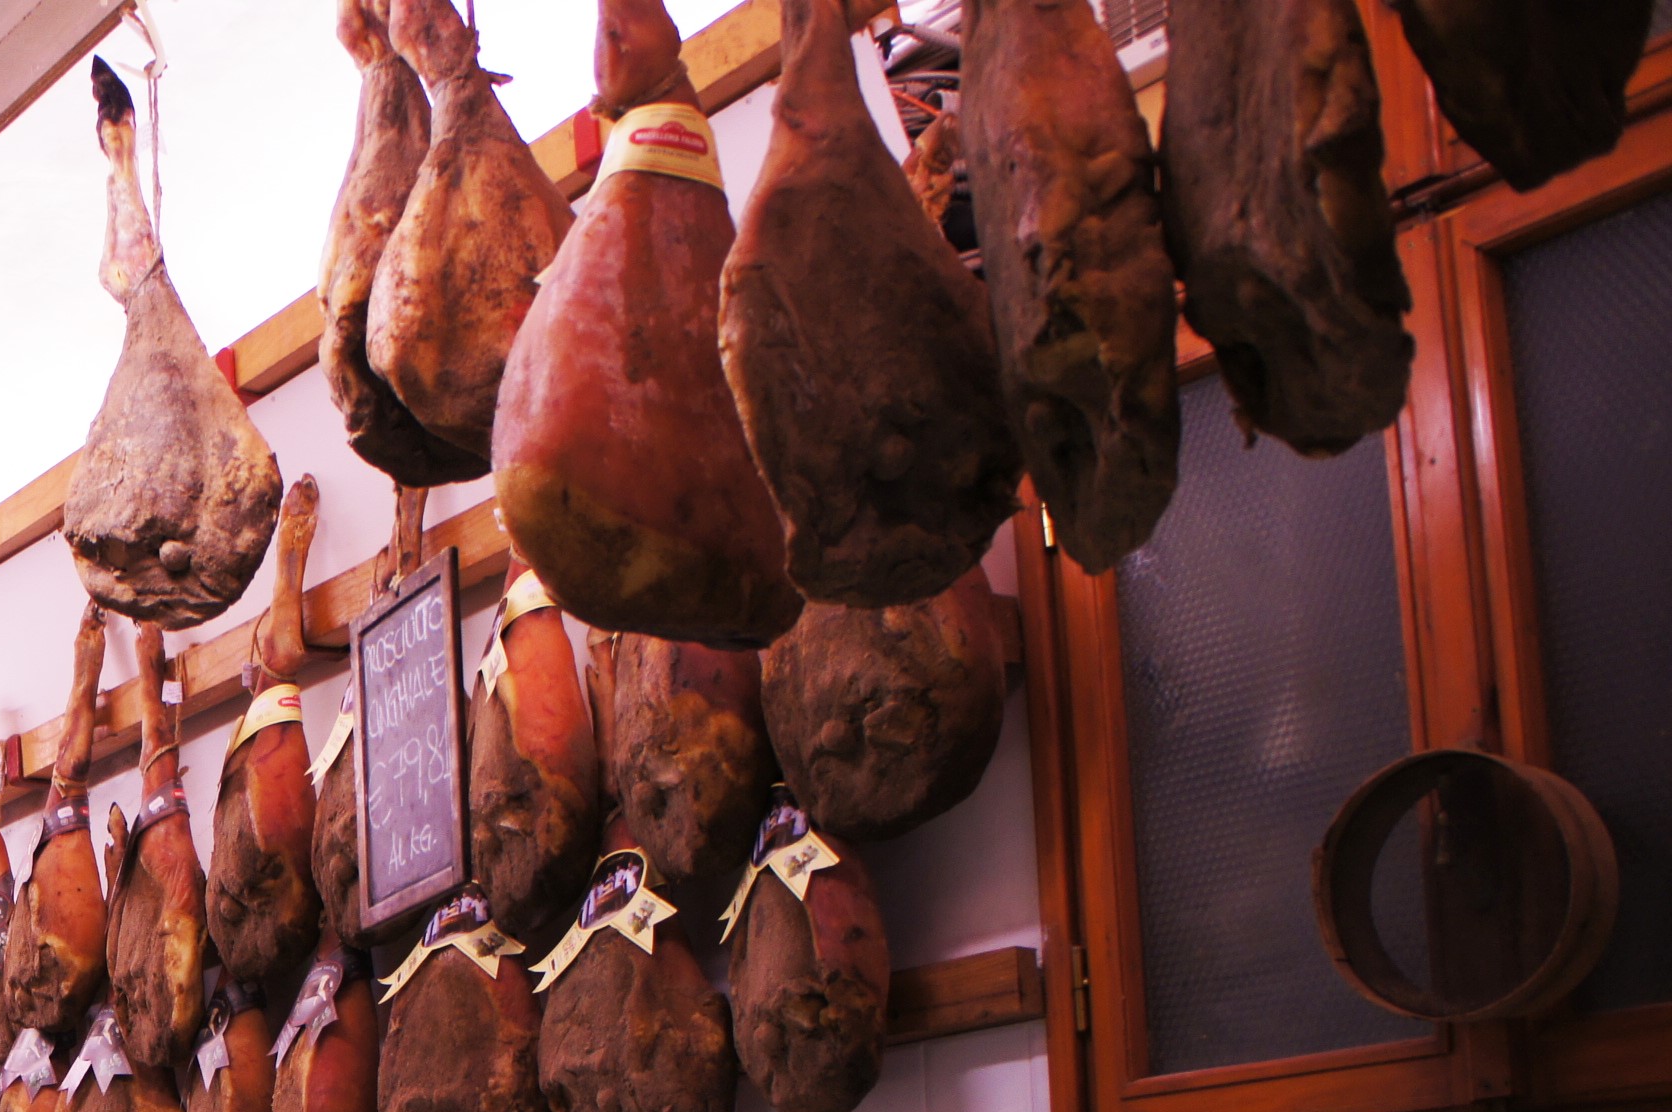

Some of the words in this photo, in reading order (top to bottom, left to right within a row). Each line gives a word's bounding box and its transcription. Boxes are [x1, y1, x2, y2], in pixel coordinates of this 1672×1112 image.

[363, 594, 443, 685] PROSCIUTTO
[367, 651, 446, 739] CINGHIALE
[388, 831, 406, 876] AL
